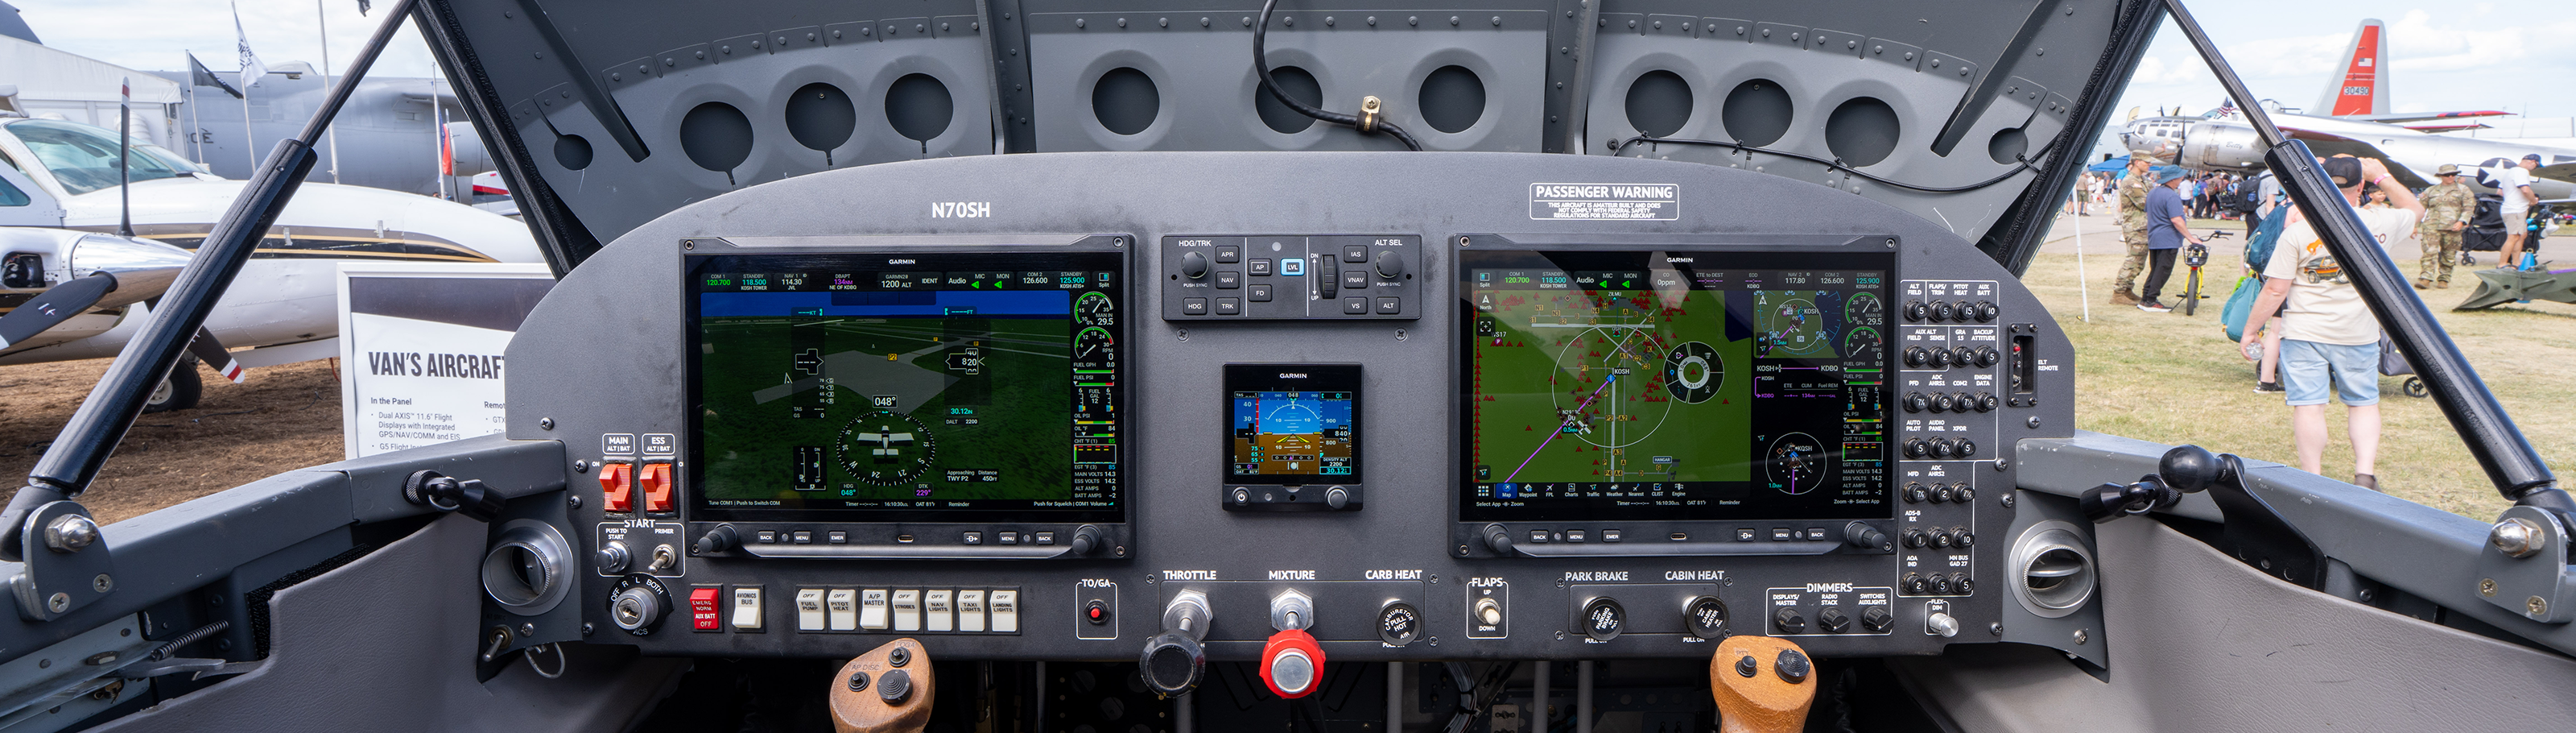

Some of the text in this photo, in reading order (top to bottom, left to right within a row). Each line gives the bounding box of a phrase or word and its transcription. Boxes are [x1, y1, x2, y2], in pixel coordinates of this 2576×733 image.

[1537, 186, 1672, 198] PASSENGER WARNING
[932, 202, 990, 217] N70SH
[369, 352, 422, 376] VAN'S
[379, 431, 435, 439] GPS/NAV/COMM
[624, 520, 655, 528] START
[1163, 570, 1216, 580] THROTTLE
[1269, 570, 1315, 580] MIXTURE
[1365, 570, 1422, 579] CARB HEAT
[1566, 572, 1628, 581] PARK BRAKE
[1666, 571, 1724, 580] CABIN HEAT
[1082, 579, 1110, 588] TO/GA
[1472, 578, 1503, 586] FLAPS
[610, 588, 621, 601] OFF
[646, 579, 663, 594] BOTH
[1807, 583, 1852, 592] DIMMERS
[1390, 616, 1406, 626] PULL
[1393, 622, 1407, 632] HOT
